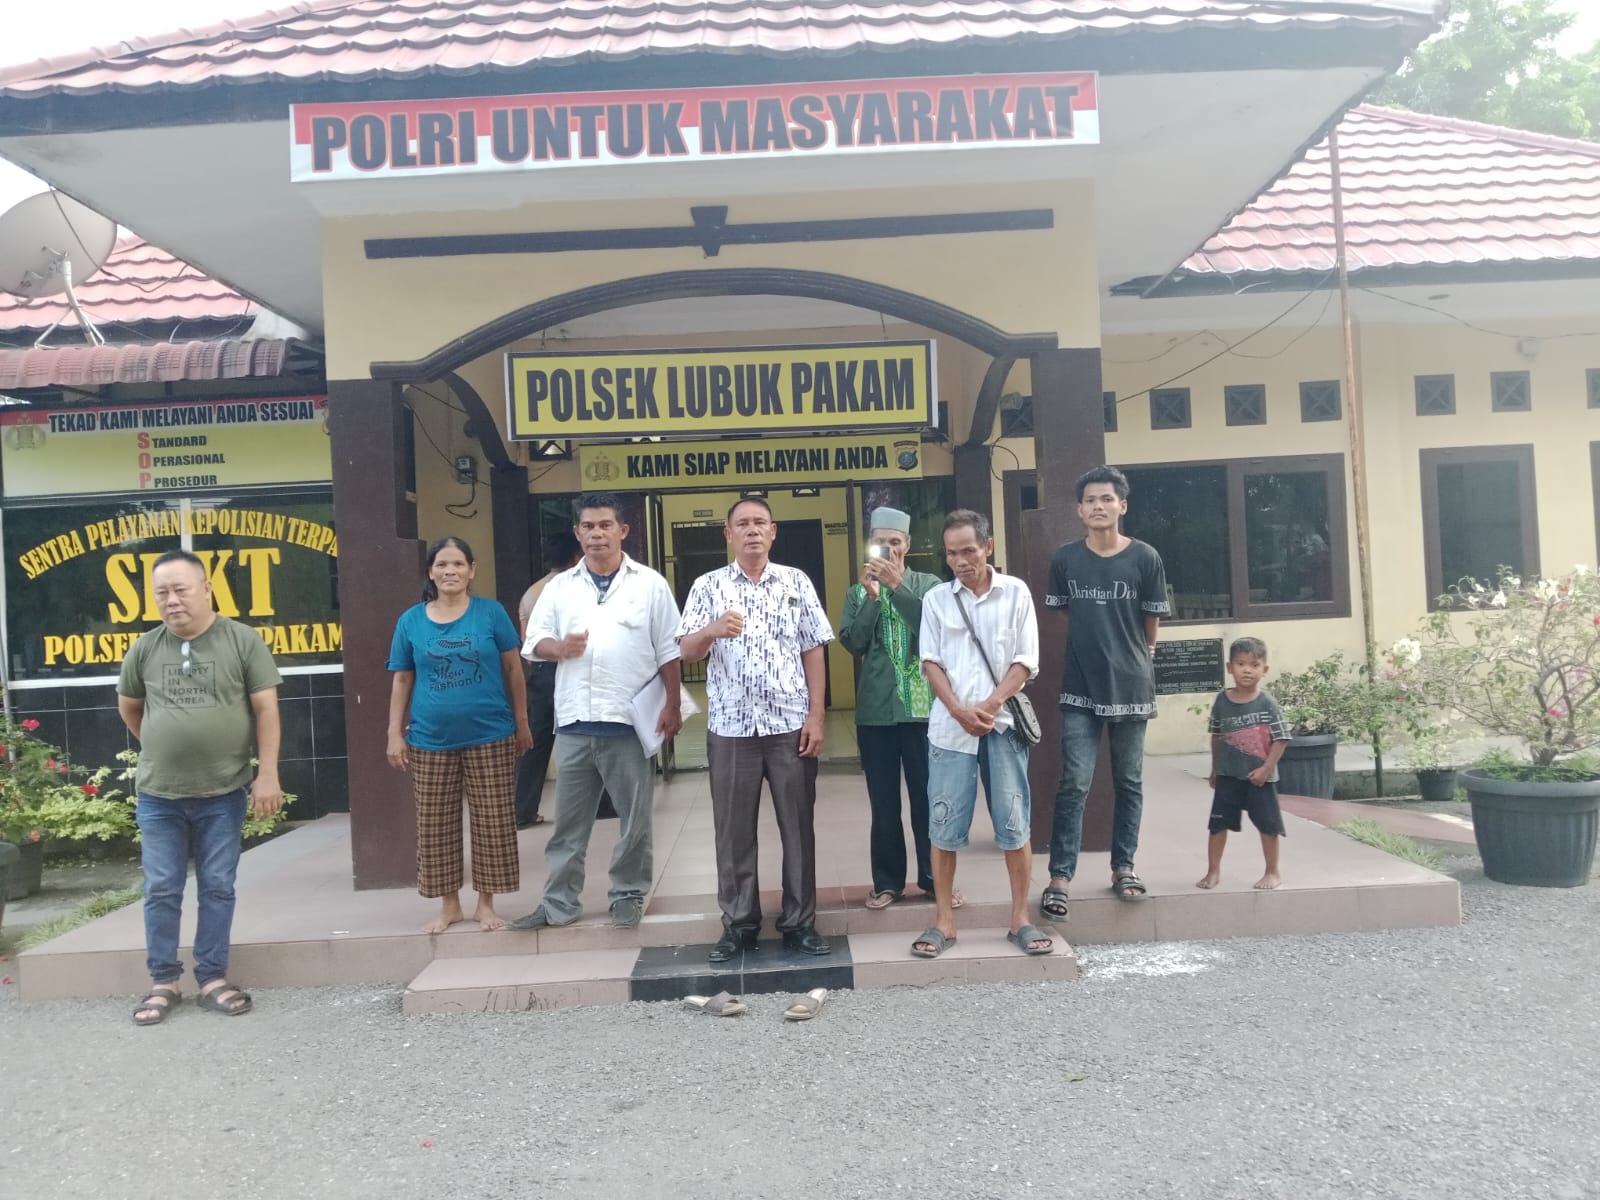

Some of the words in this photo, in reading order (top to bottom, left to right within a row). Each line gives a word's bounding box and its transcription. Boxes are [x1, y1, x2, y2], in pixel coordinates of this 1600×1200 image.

[311, 110, 478, 172] POLRI
[491, 102, 690, 163] UNTUK
[700, 85, 1079, 154] MASYARAKAT
[526, 366, 660, 422] POLSEK
[667, 362, 784, 418] LUBUK
[791, 358, 915, 414] PAKAM
[48, 412, 96, 433] TEKAD
[100, 408, 139, 431] KAMI
[142, 405, 213, 428] MELAYANI
[216, 403, 257, 424] ANDA
[260, 400, 314, 422] SESUAI
[626, 454, 680, 478] KAMI
[684, 451, 729, 476] SIAP
[735, 448, 830, 474] MELAYANI
[834, 445, 888, 470] ANDA
[19, 529, 86, 580] SENTRA
[84, 510, 180, 551] PELAYANAN
[184, 508, 286, 541] KEPOLISIAN
[168, 666, 209, 676] LIBRTY
[168, 678, 180, 686] IN
[168, 687, 208, 696] NORTH
